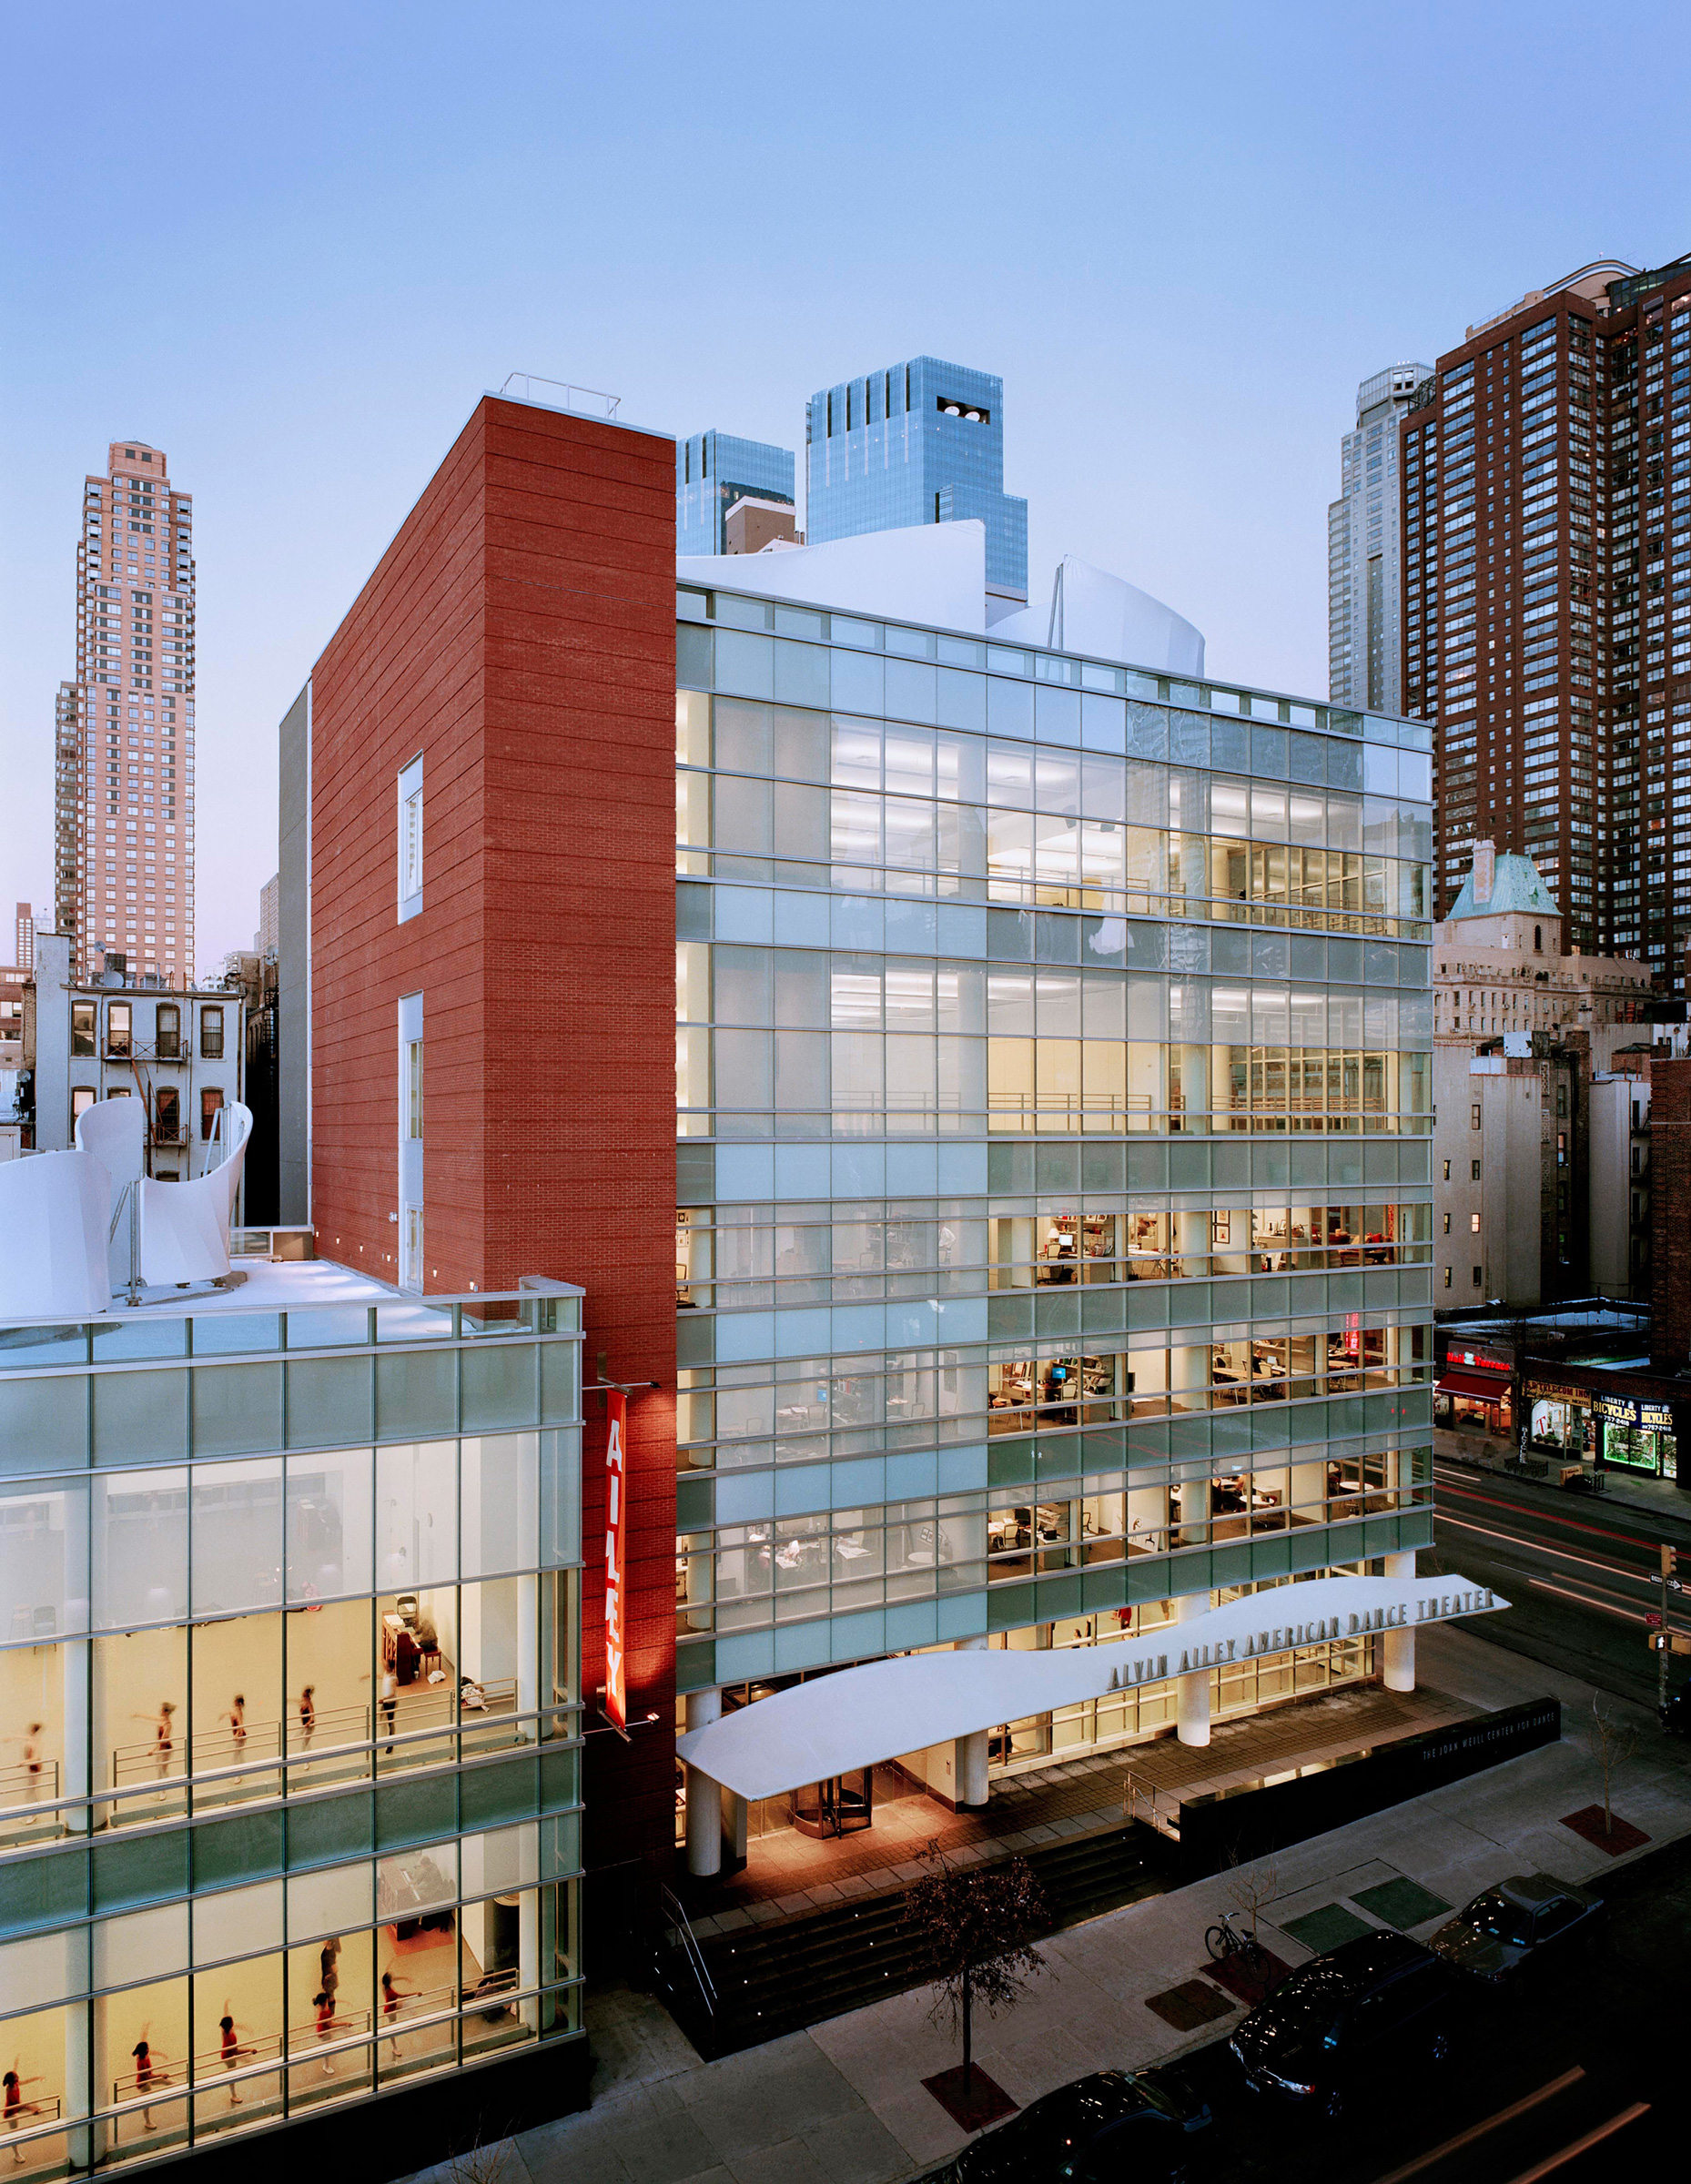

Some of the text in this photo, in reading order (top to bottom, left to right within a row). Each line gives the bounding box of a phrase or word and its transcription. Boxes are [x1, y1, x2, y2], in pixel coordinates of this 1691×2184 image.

[1593, 1400, 1637, 1421] BICYCLES
[1600, 1394, 1625, 1407] LIBERTY
[1641, 1403, 1662, 1412] LIBERTY
[1641, 1411, 1674, 1425] BICYCLES
[605, 1419, 623, 1696] AILEY
[1107, 1588, 1494, 1691] ALVIN AILEY AMERICAN DANCE THEATER
[1423, 1712, 1555, 1760] THE JOAN WEILL CENTER FOR DANCE
